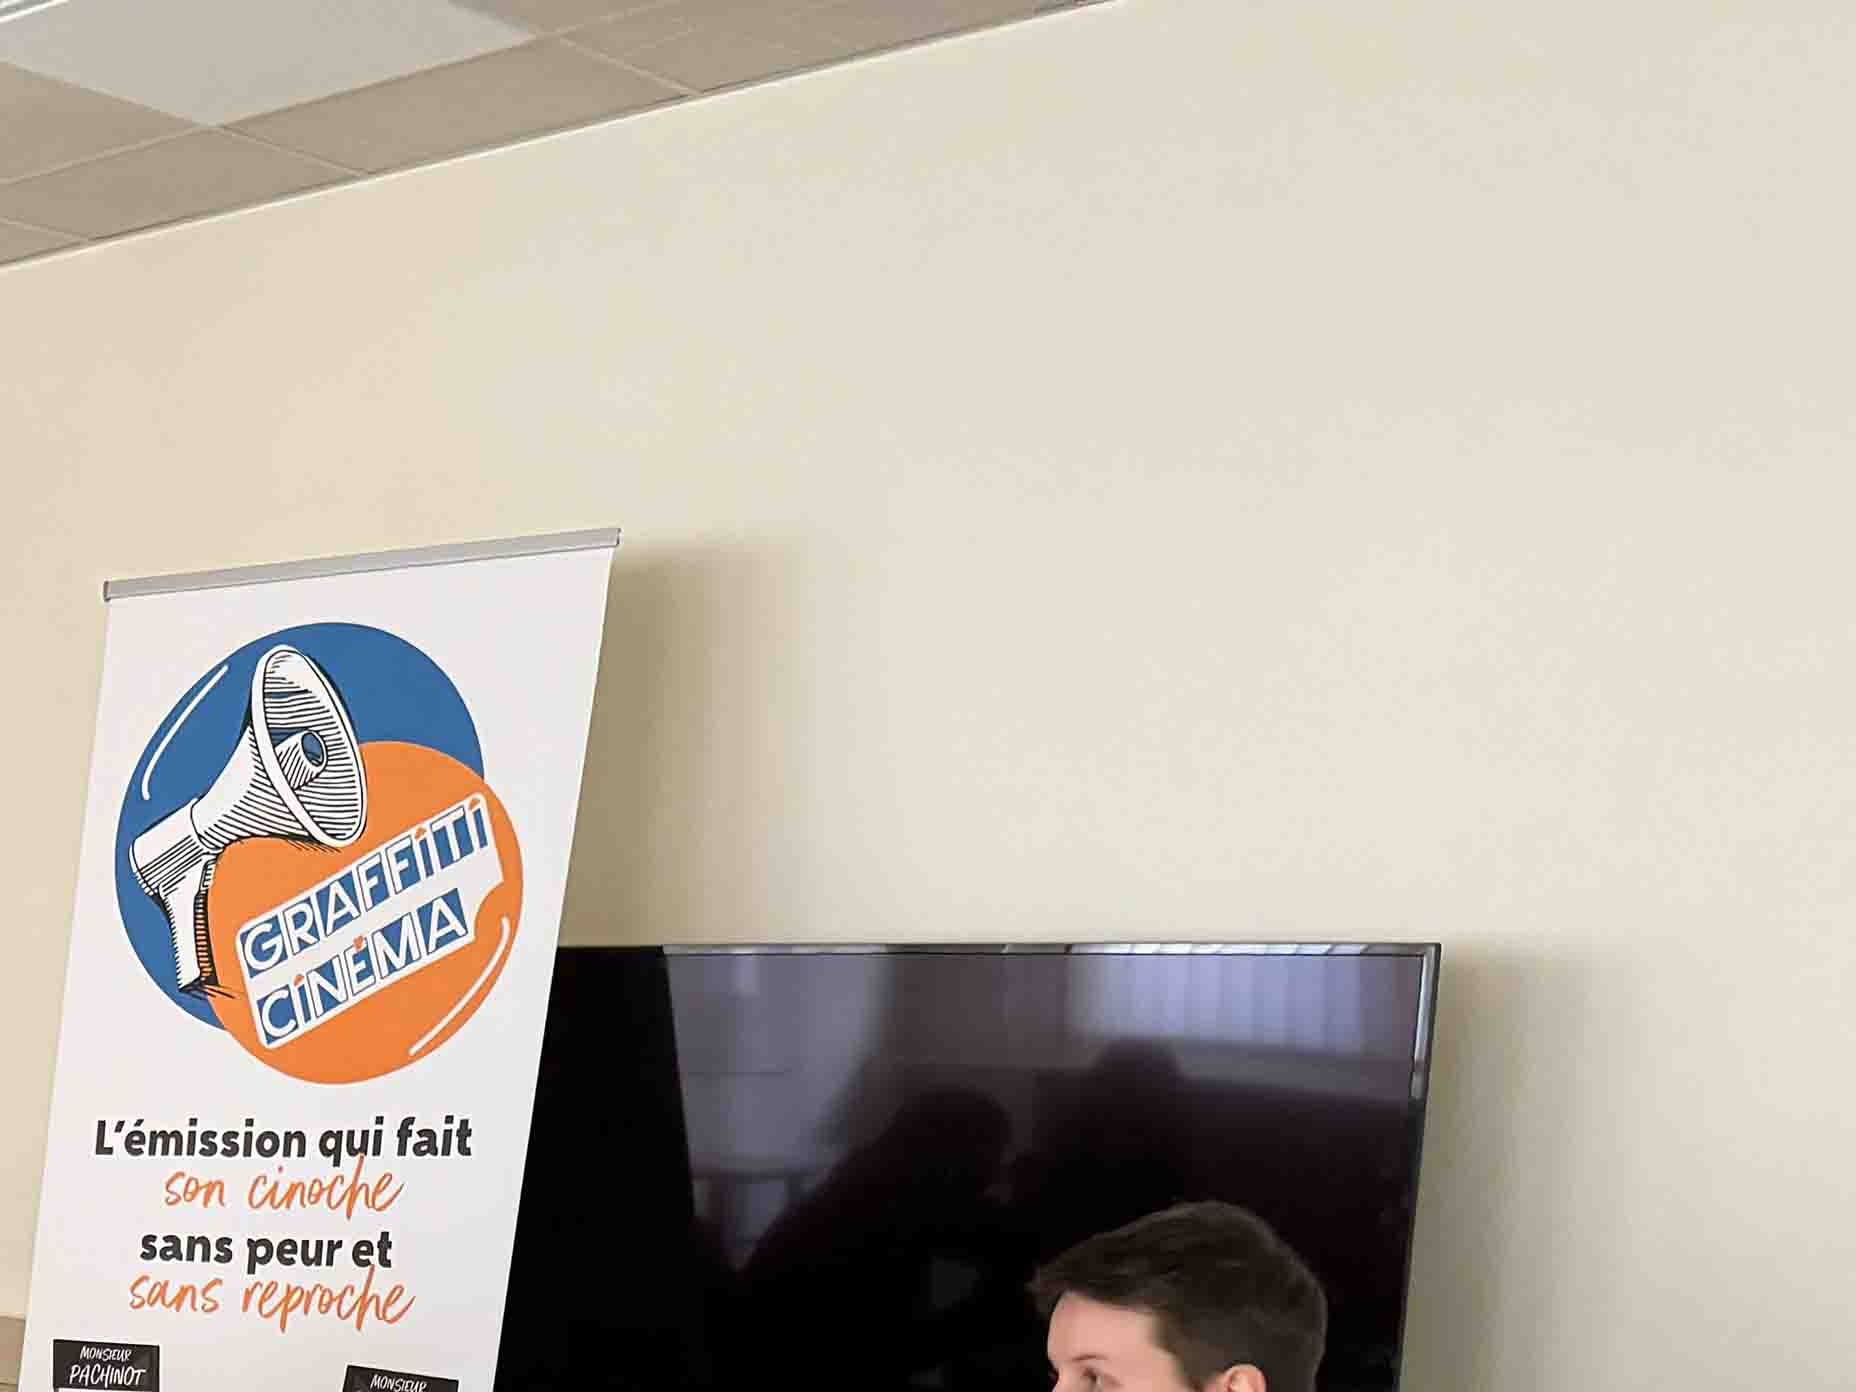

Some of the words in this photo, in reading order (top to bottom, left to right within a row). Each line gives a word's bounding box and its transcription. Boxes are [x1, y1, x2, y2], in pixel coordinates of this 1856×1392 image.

[95, 1117, 307, 1158] L'émission
[318, 1115, 384, 1167] qui
[395, 1114, 472, 1157] fait
[164, 1170, 225, 1208] son
[247, 1152, 404, 1220] cinoche
[140, 1233, 233, 1264] sans
[247, 1236, 343, 1274] peur
[351, 1231, 393, 1268] et
[129, 1274, 224, 1313] sans
[241, 1264, 417, 1333] reproche
[69, 1363, 147, 1388] PACHINOT
[79, 1345, 132, 1362] MONSIEUR
